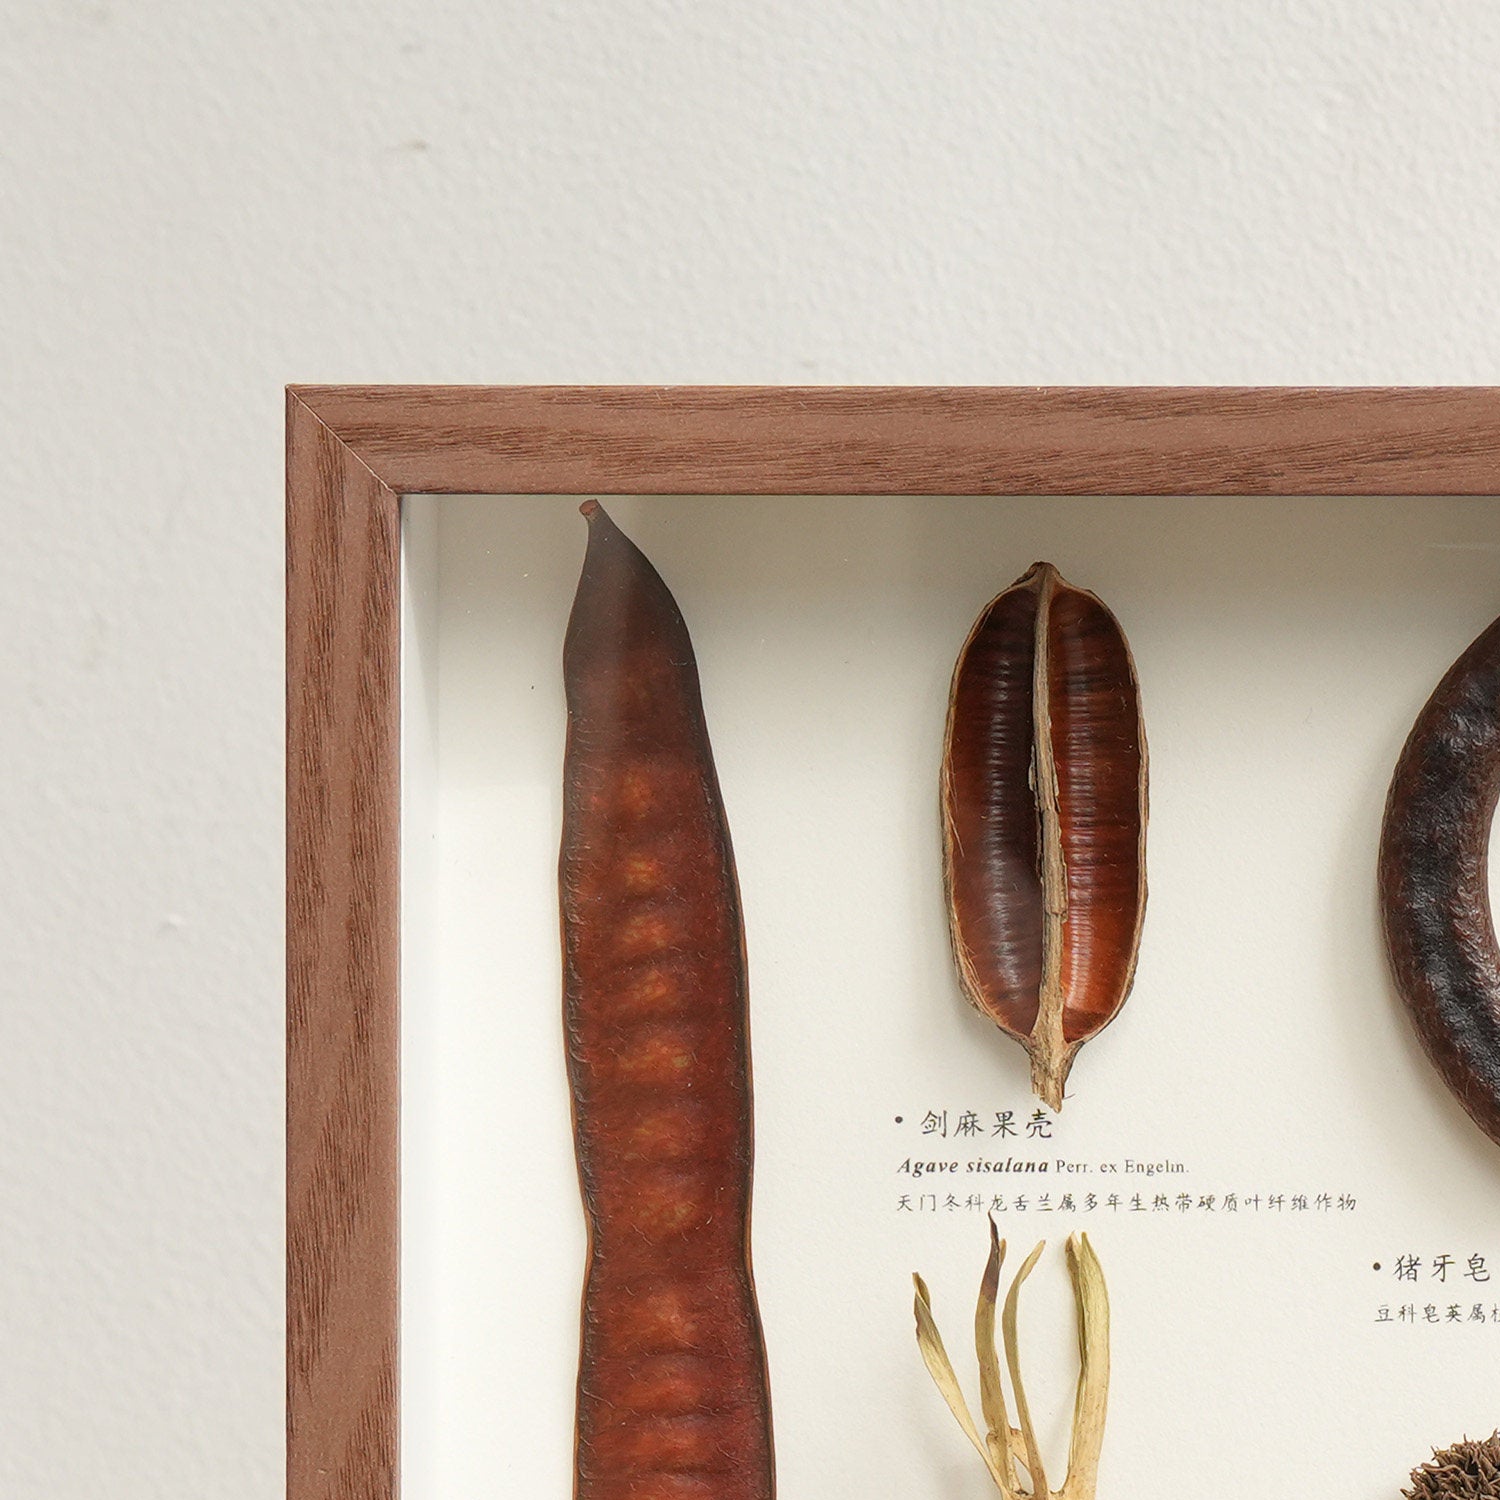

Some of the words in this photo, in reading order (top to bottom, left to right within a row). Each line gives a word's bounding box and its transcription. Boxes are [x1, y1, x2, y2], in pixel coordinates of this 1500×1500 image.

[919, 1109, 1054, 1139] 剑麻果壳
[896, 1157, 960, 1177] Agave
[966, 1157, 1050, 1174] sisalana
[1055, 1159, 1094, 1174] Perr.
[1099, 1162, 1118, 1174] ex
[1392, 1253, 1491, 1283] 猪牙皂
